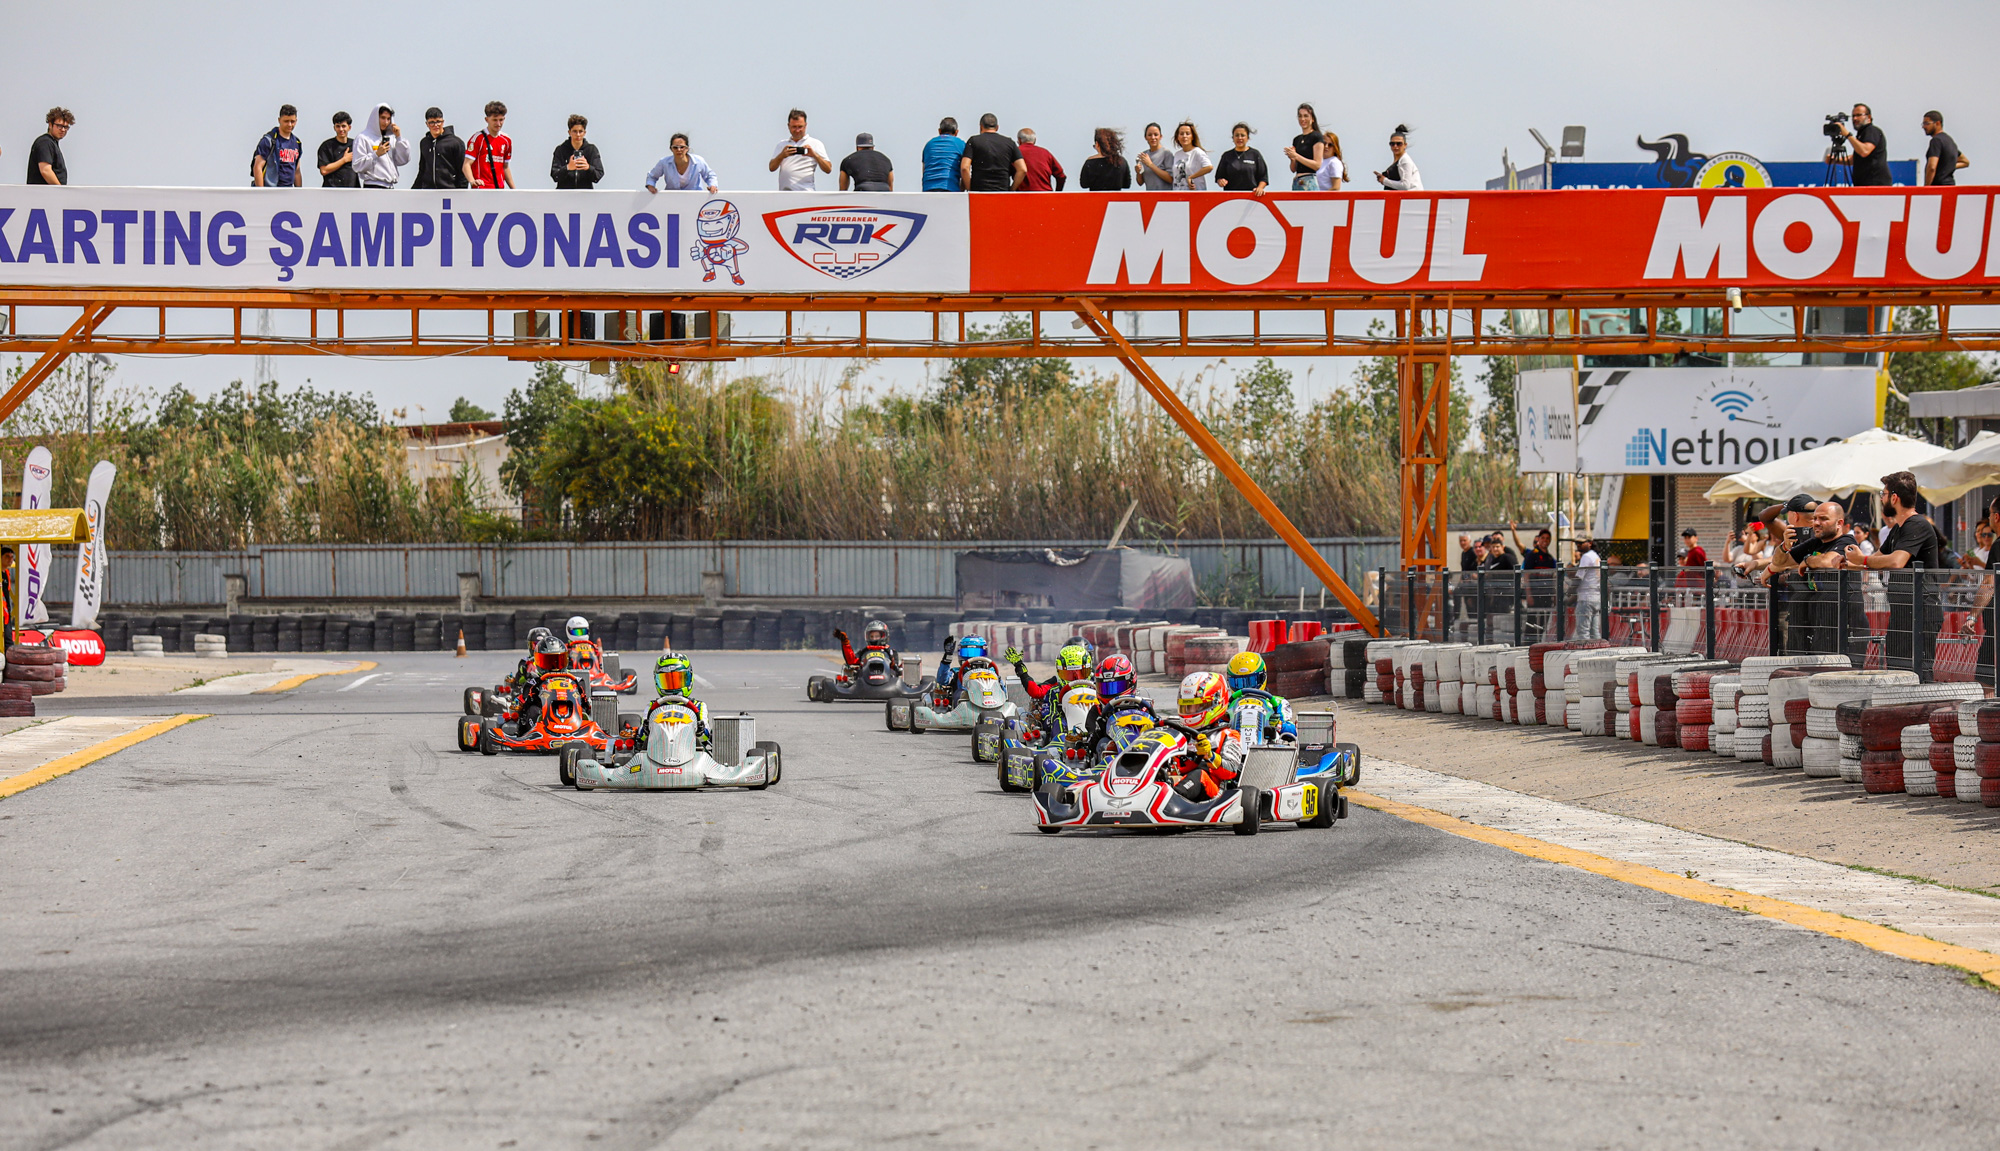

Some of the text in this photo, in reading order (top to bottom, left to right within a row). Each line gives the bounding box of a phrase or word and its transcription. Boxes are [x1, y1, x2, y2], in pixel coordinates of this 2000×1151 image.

[270, 198, 680, 282] ŞAMPİYONASI
[793, 223, 898, 251] ROK
[1087, 198, 1487, 286] MOTUL
[1643, 193, 2000, 280] MOTU
[813, 253, 880, 264] CUP
[60, 639, 101, 654] MOTUL
[1306, 788, 1317, 816] 95
